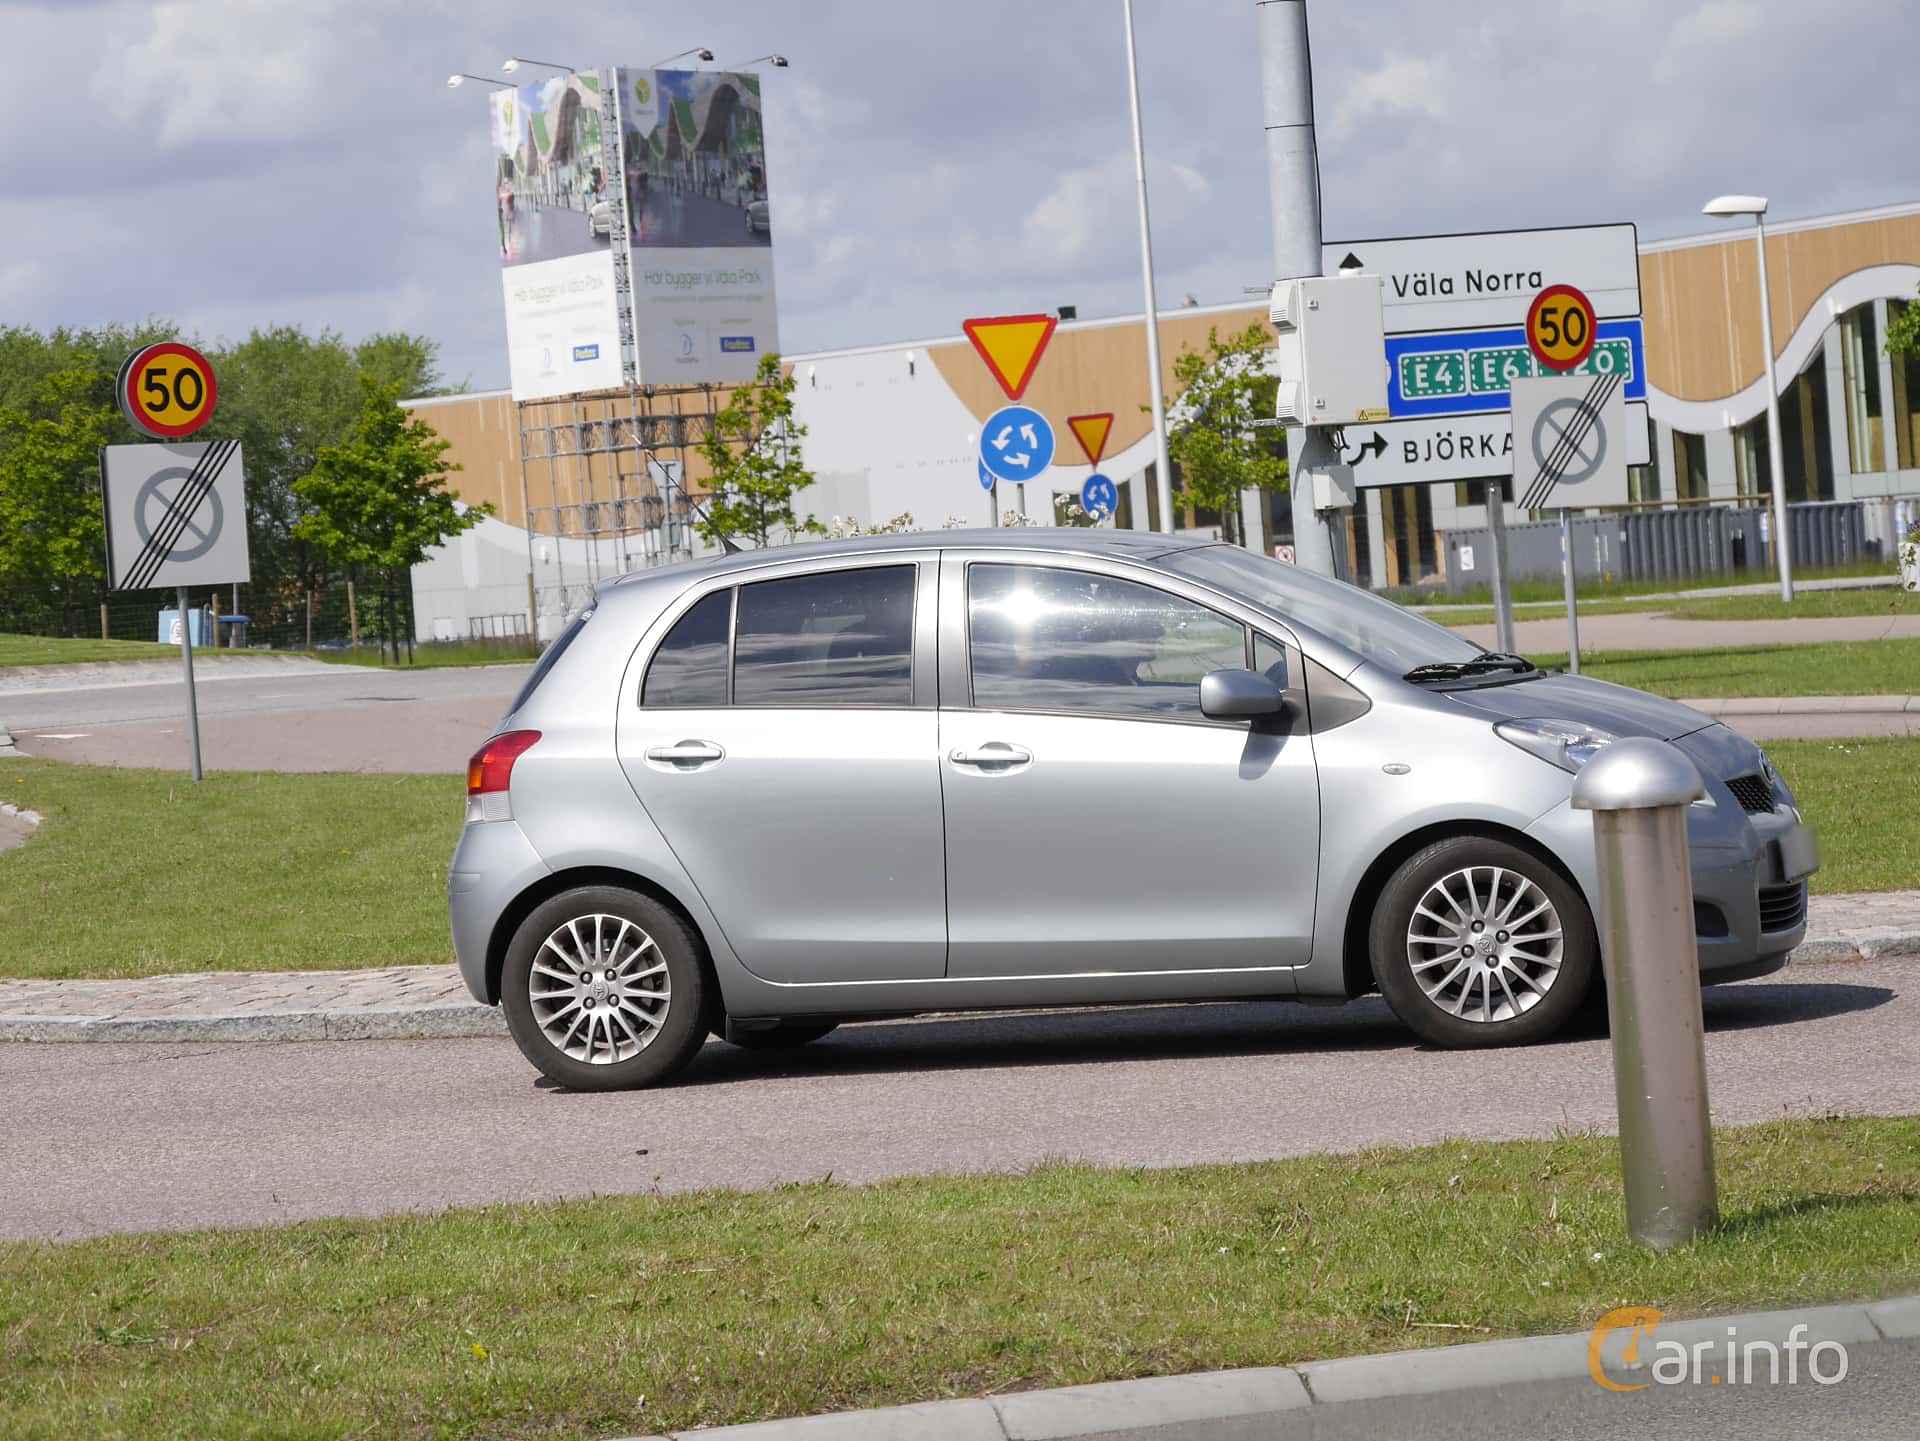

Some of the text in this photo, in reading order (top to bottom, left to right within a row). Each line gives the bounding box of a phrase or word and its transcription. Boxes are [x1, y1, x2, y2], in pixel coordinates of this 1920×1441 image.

[1391, 270, 1543, 298] Väla Norra
[1539, 307, 1587, 348] 50
[1415, 362, 1453, 388] E4
[1483, 356, 1521, 383] E6
[144, 367, 204, 413] 50
[1403, 431, 1513, 464] BJÖRKA
